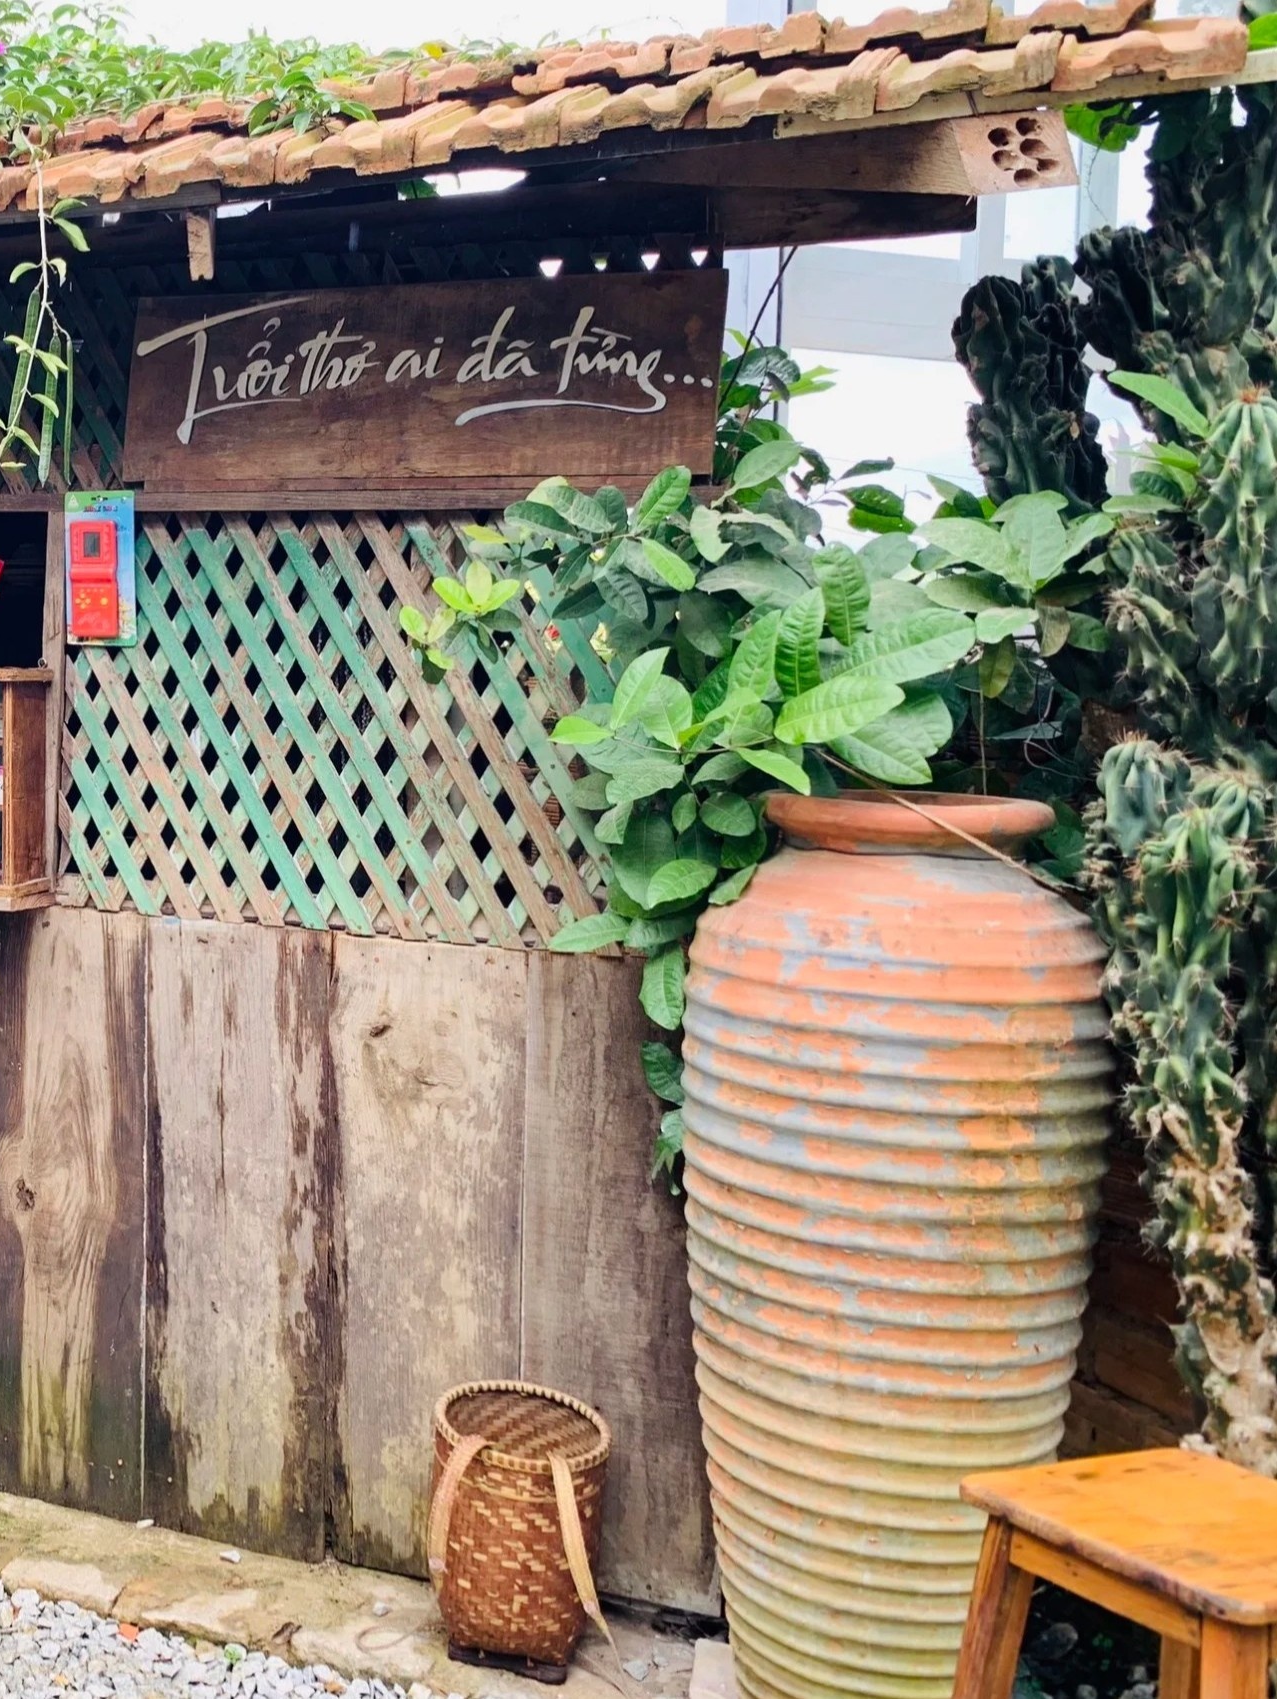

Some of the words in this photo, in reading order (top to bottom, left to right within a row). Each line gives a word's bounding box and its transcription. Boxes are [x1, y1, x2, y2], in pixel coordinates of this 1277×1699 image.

[135, 297, 311, 445] Tuổi
[298, 316, 381, 395] thơ
[385, 336, 446, 383] ai
[456, 305, 540, 384] đã
